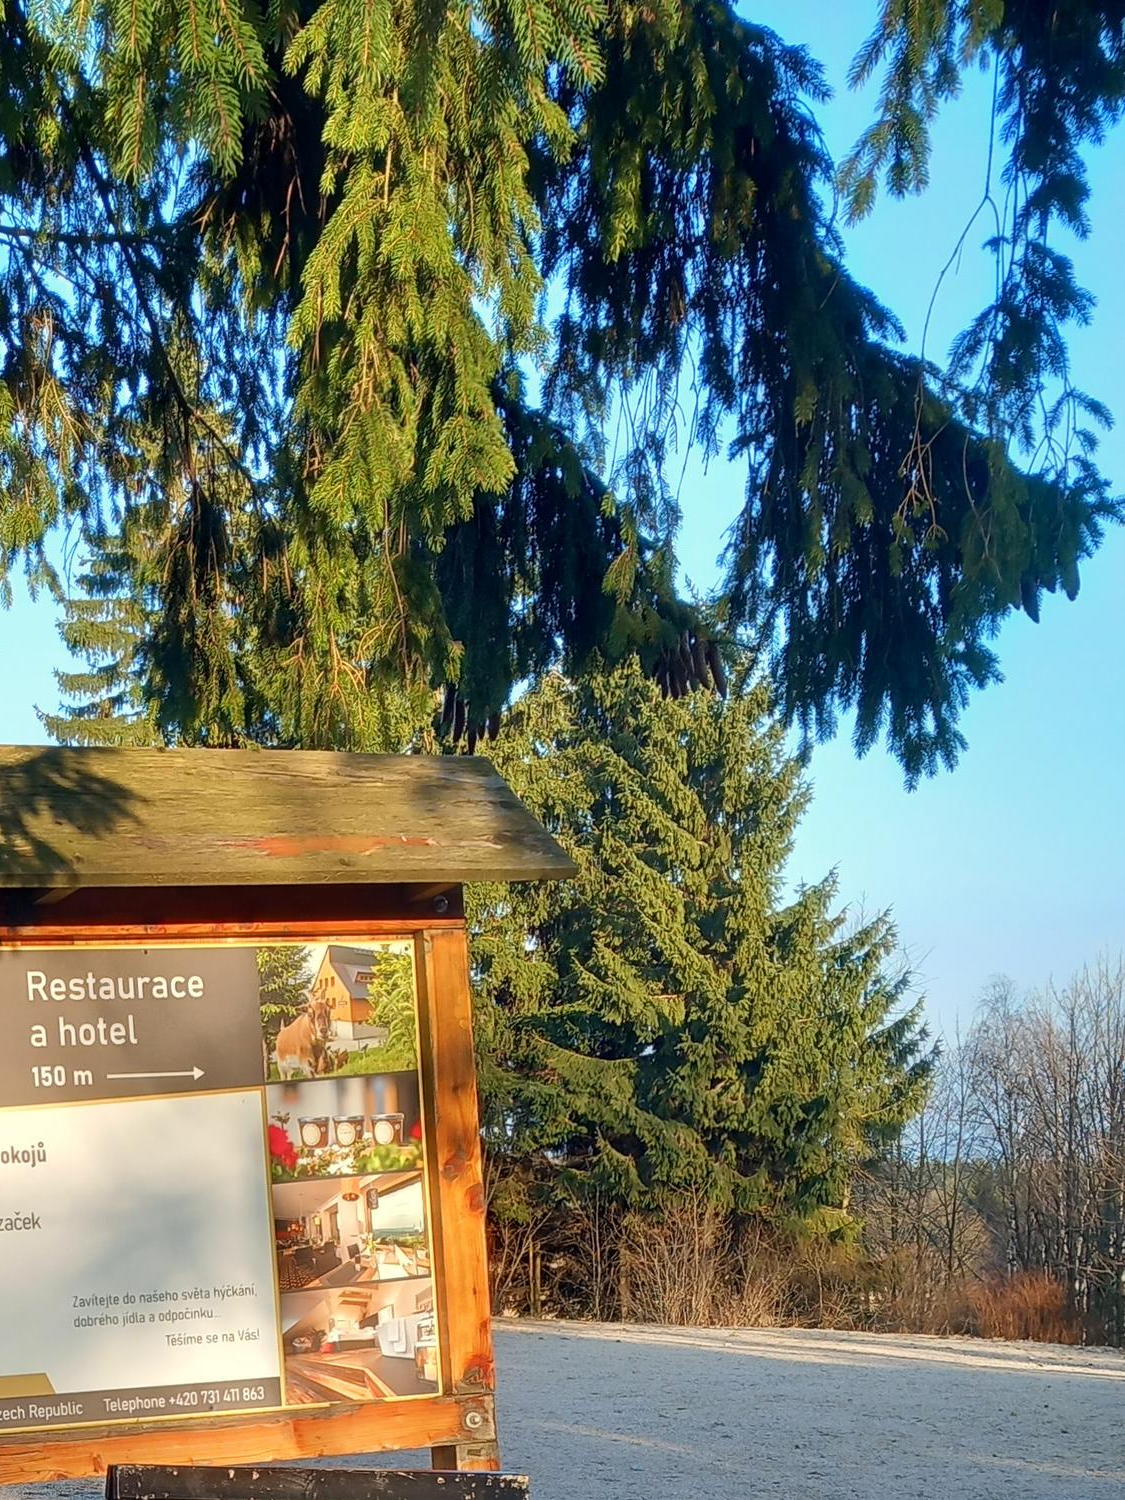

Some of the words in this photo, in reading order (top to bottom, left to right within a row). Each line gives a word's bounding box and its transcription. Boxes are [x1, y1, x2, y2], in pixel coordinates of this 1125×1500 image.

[26, 970, 204, 1002] Restaurace
[29, 1022, 49, 1048] a
[59, 1014, 138, 1047] hotel
[31, 1065, 67, 1088] 150
[74, 1069, 94, 1087] m
[73, 1293, 120, 1309] Zavítejte
[123, 1292, 137, 1305] do
[139, 1289, 179, 1304] našeho
[181, 1286, 211, 1301] světa
[73, 1312, 119, 1328] dobrého
[122, 1310, 146, 1327] jídla
[149, 1313, 156, 1323] a
[164, 1331, 203, 1347] Těšíme
[205, 1334, 219, 1344] se
[222, 1332, 235, 1343] na
[237, 1328, 260, 1342] Vás!
[29, 1401, 84, 1421] Republic
[103, 1396, 166, 1413] Telephone
[169, 1391, 198, 1406] +420
[200, 1389, 220, 1404] 731
[222, 1388, 240, 1402] 411
[242, 1386, 265, 1401] 863
